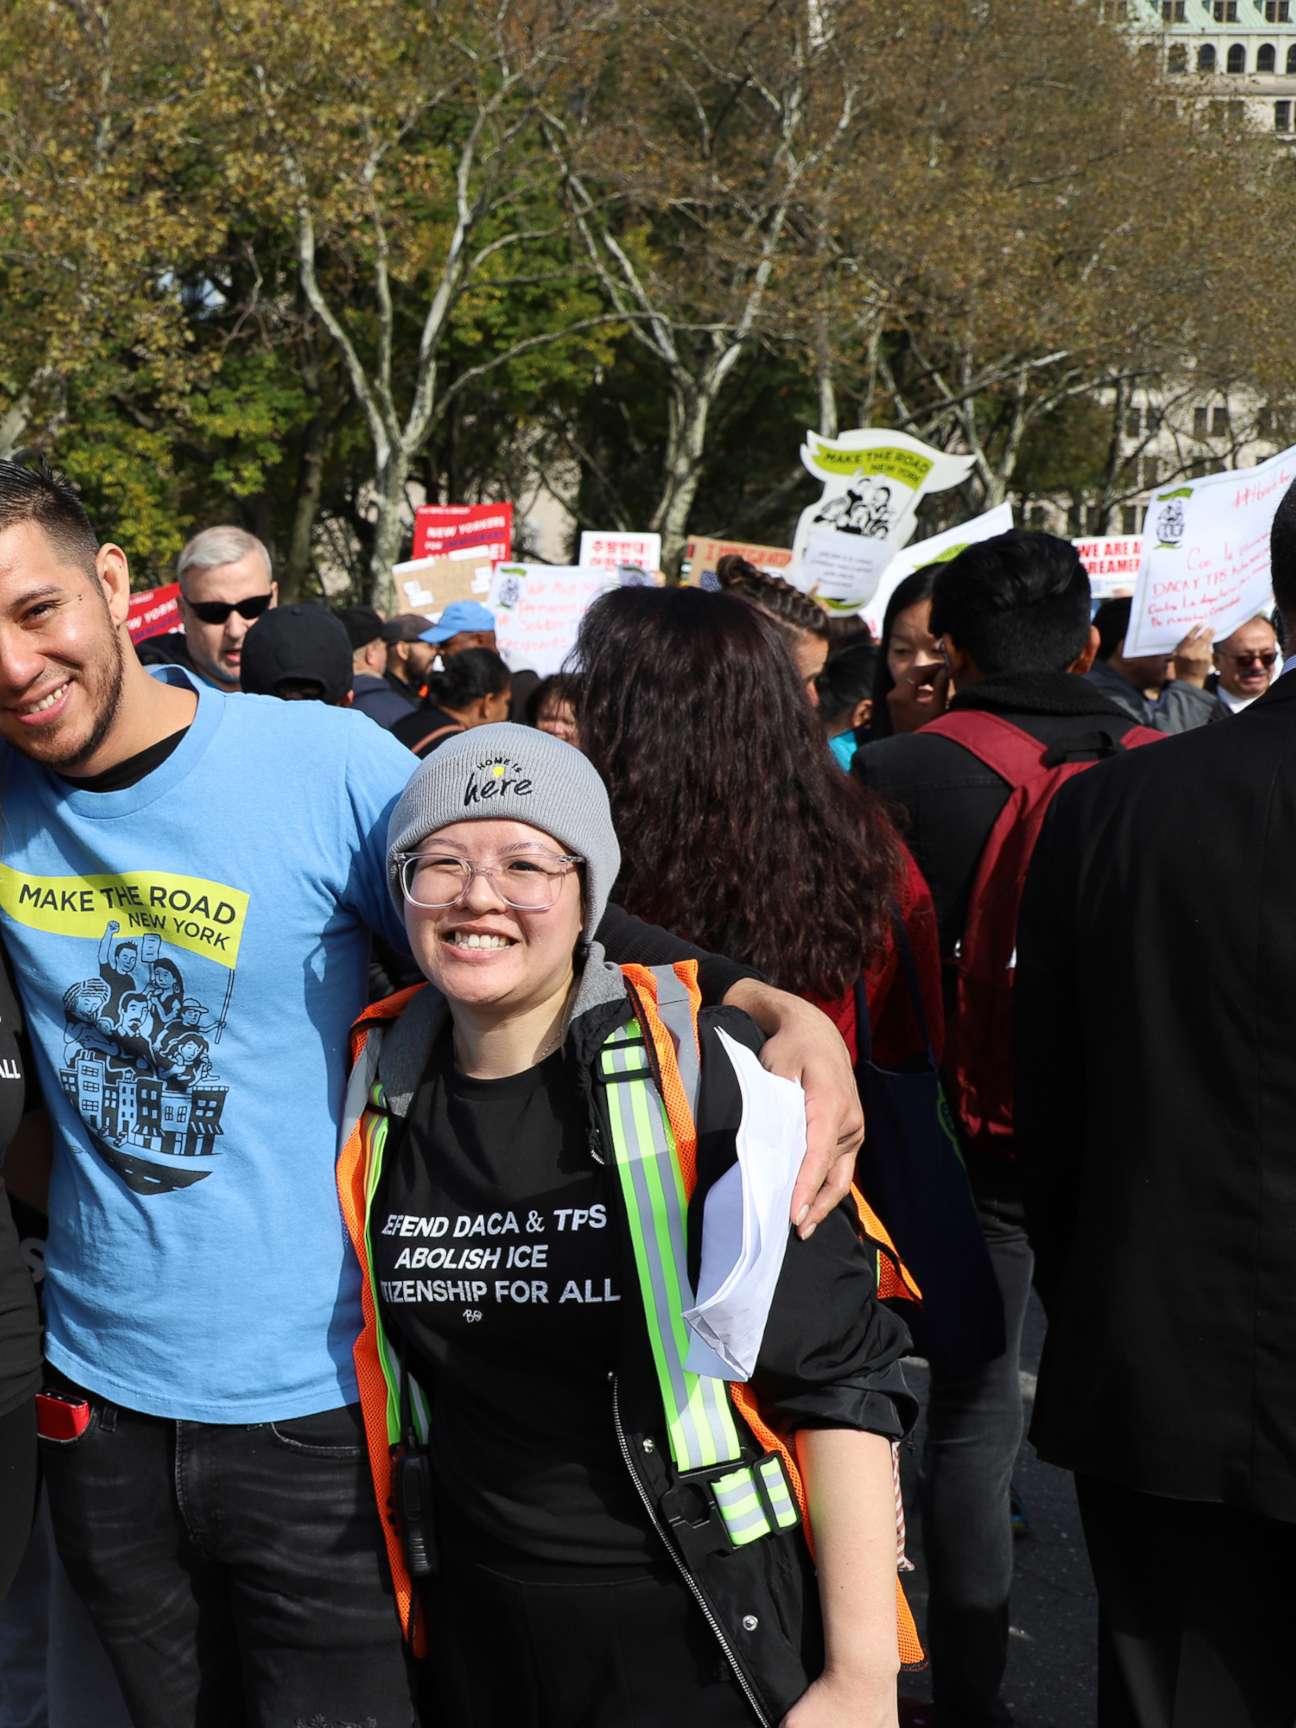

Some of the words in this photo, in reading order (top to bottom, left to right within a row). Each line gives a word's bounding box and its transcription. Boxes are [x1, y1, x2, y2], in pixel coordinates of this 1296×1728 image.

[826, 453, 861, 464] MAKE
[867, 451, 892, 462] THE
[895, 452, 930, 473] ROAD
[871, 464, 895, 472] NEW
[898, 467, 920, 482] YORK
[426, 526, 457, 538] NEW
[1077, 543, 1098, 557] WE
[1105, 542, 1128, 555] ARE
[477, 757, 510, 770] HOME
[464, 772, 532, 806] here
[18, 884, 95, 912] MAKE
[100, 885, 143, 908] THE
[150, 886, 236, 925] ROAD
[128, 911, 167, 929] NEW
[174, 918, 232, 951] YORK
[381, 1214, 448, 1237] EFEND
[453, 1211, 519, 1238] DACA
[526, 1210, 545, 1232] &
[553, 1204, 607, 1231] TPS
[394, 1247, 502, 1269] ABOLISH
[506, 1244, 549, 1269] ICE
[495, 1280, 549, 1303] FOR
[559, 1278, 621, 1303] ALL
